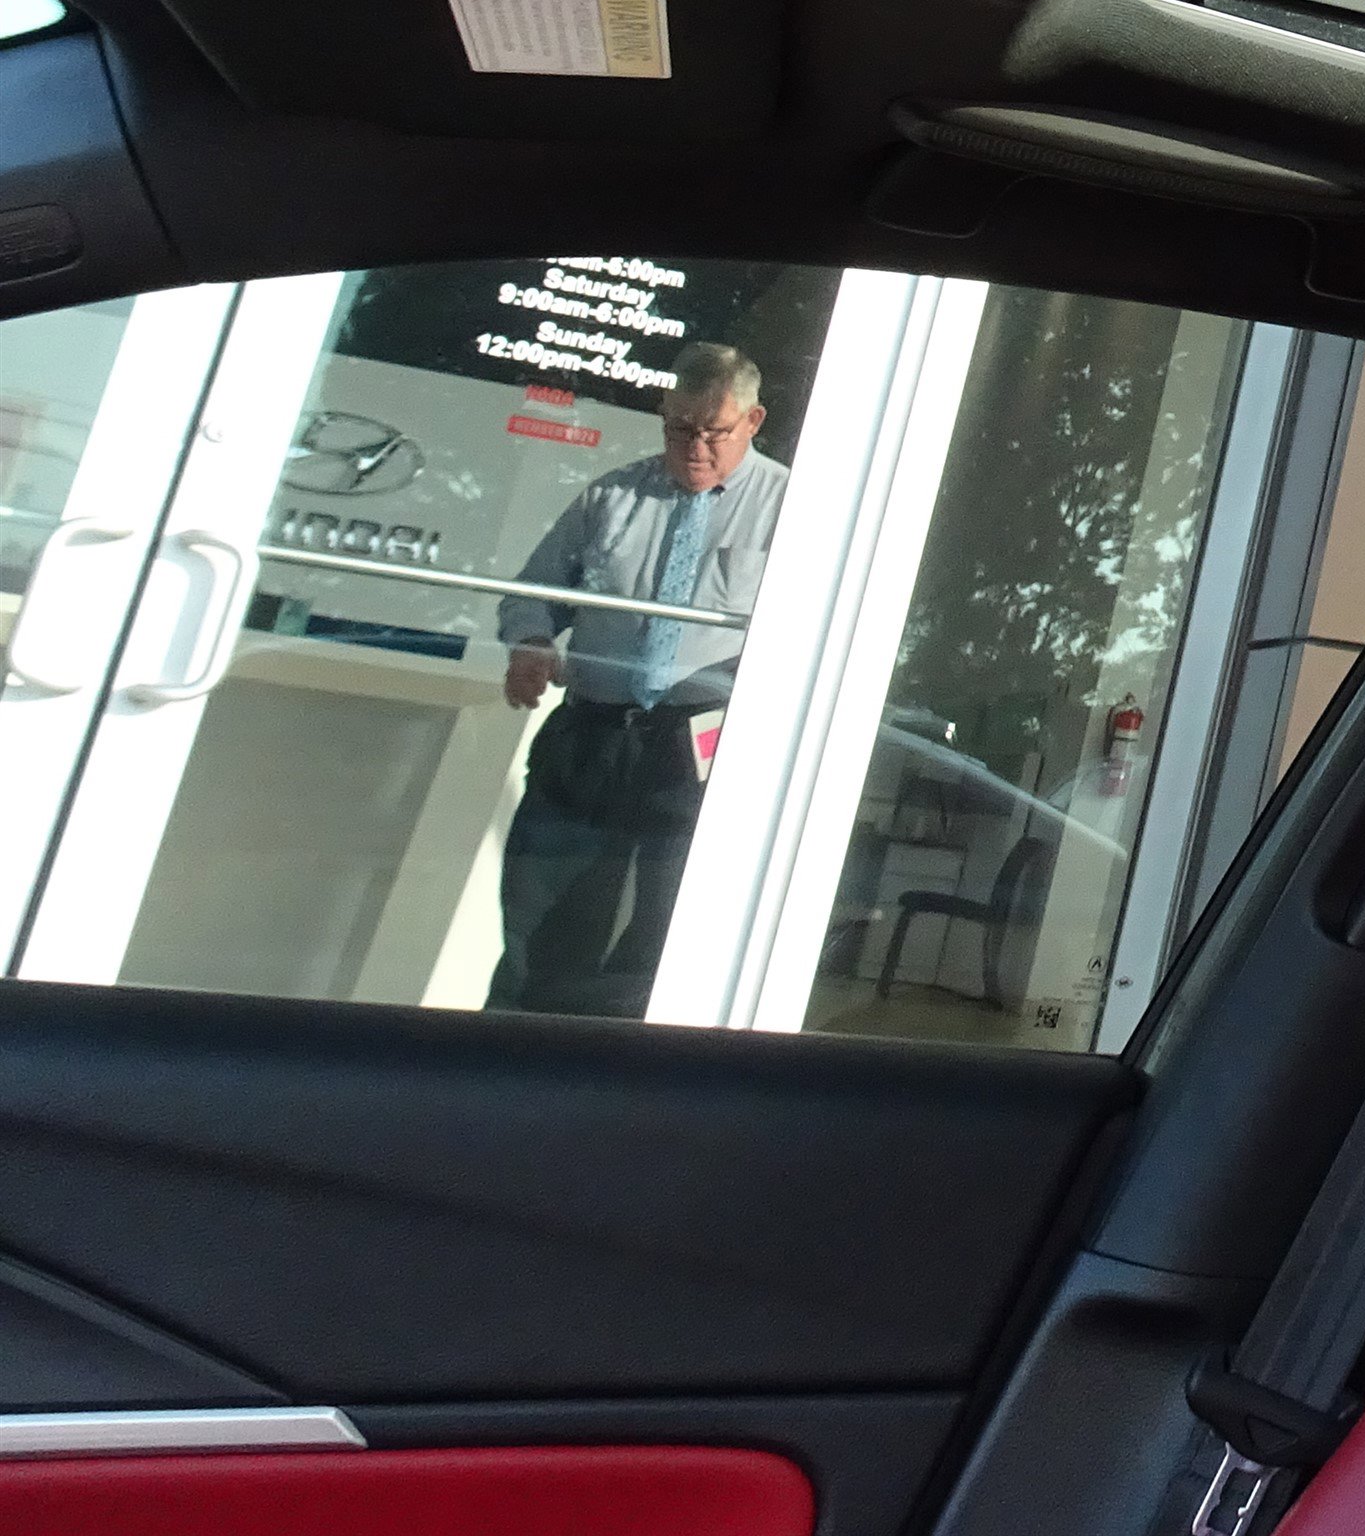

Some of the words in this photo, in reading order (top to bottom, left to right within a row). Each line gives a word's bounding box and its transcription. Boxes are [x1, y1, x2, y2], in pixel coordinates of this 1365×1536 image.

[606, 0, 652, 61] WARNING
[497, 282, 686, 338] 9:00am-6:00pm
[542, 267, 656, 311] Saturday
[475, 332, 679, 390] 12:00pm-4:00pm
[535, 321, 633, 360] Sunday
